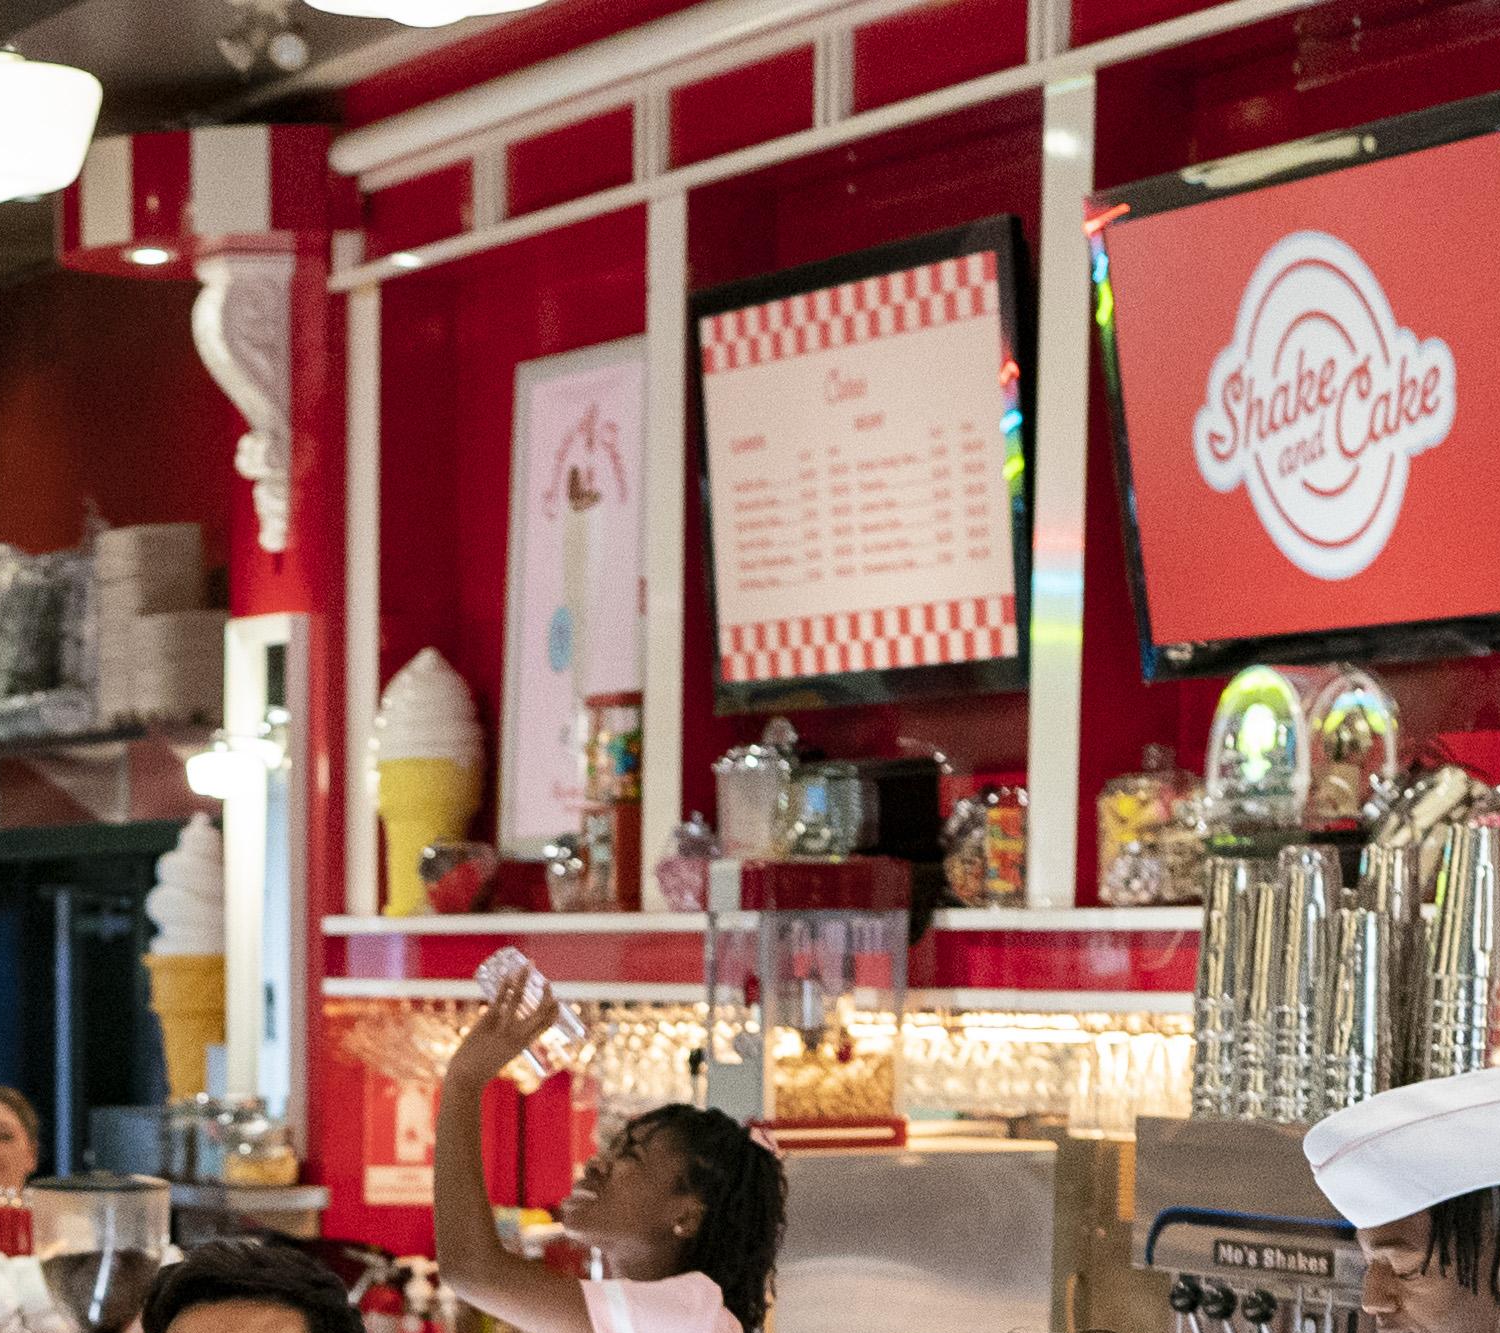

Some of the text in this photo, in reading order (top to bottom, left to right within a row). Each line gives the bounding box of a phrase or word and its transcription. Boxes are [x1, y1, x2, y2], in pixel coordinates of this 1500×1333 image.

[1208, 350, 1336, 463] Shake
[1278, 353, 1440, 478] and Cake
[1219, 1243, 1258, 1267] Mo's
